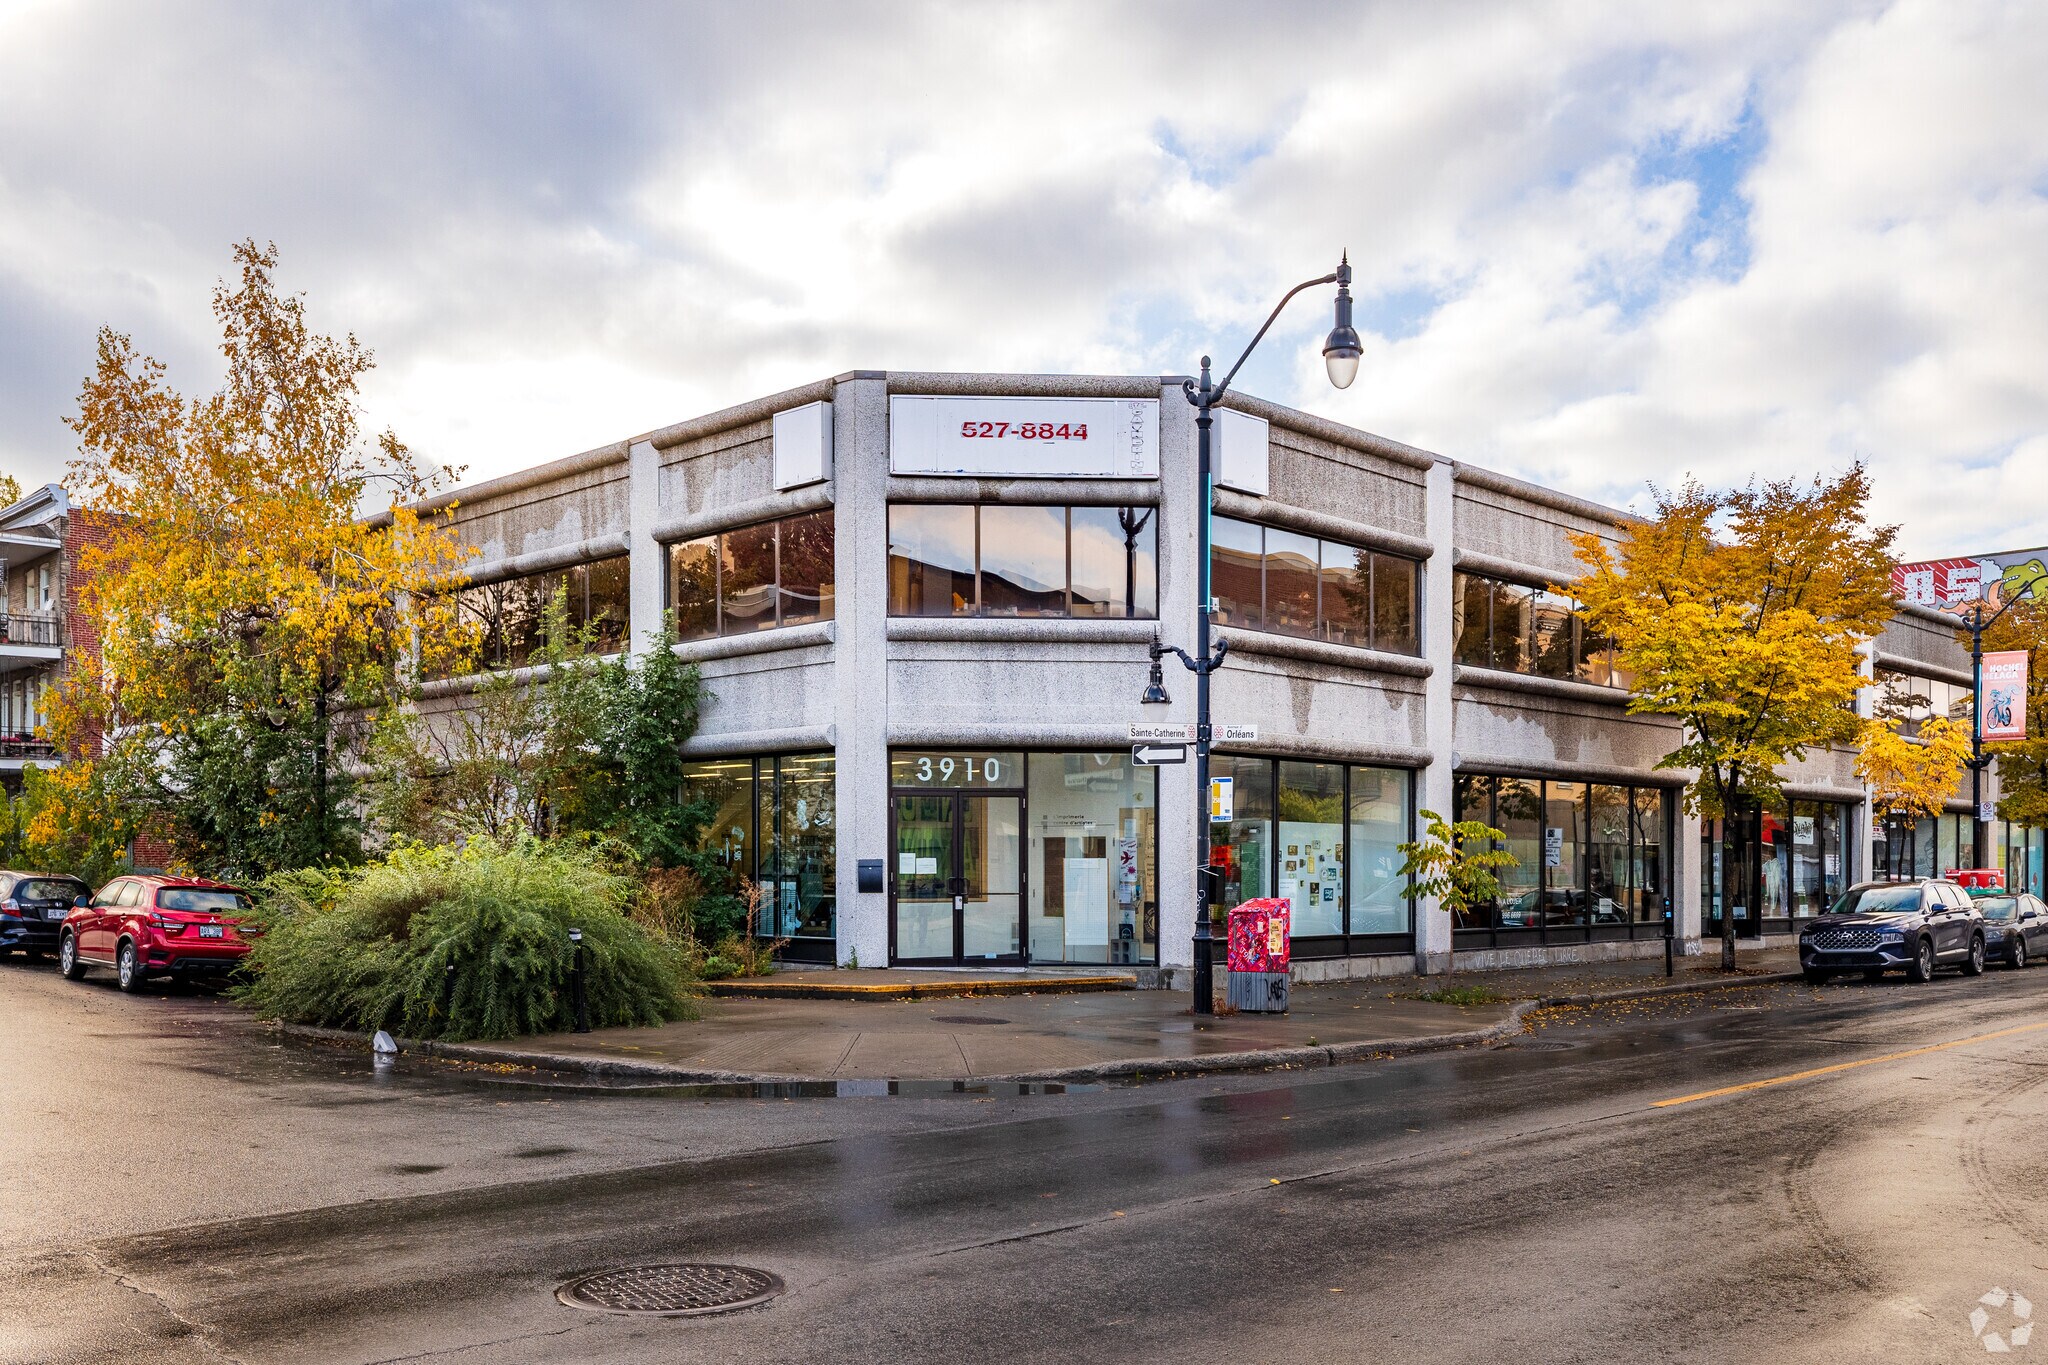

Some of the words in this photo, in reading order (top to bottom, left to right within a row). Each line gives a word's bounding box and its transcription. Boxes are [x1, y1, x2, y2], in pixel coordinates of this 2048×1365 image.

[962, 421, 1087, 440] 527-8844
[1989, 663, 2026, 673] HOCHEL
[1983, 671, 2019, 680] HELAGA
[1130, 728, 1186, 738] Sainte-Catherine
[1226, 730, 1255, 739] Orléans
[917, 757, 1000, 782] 3910
